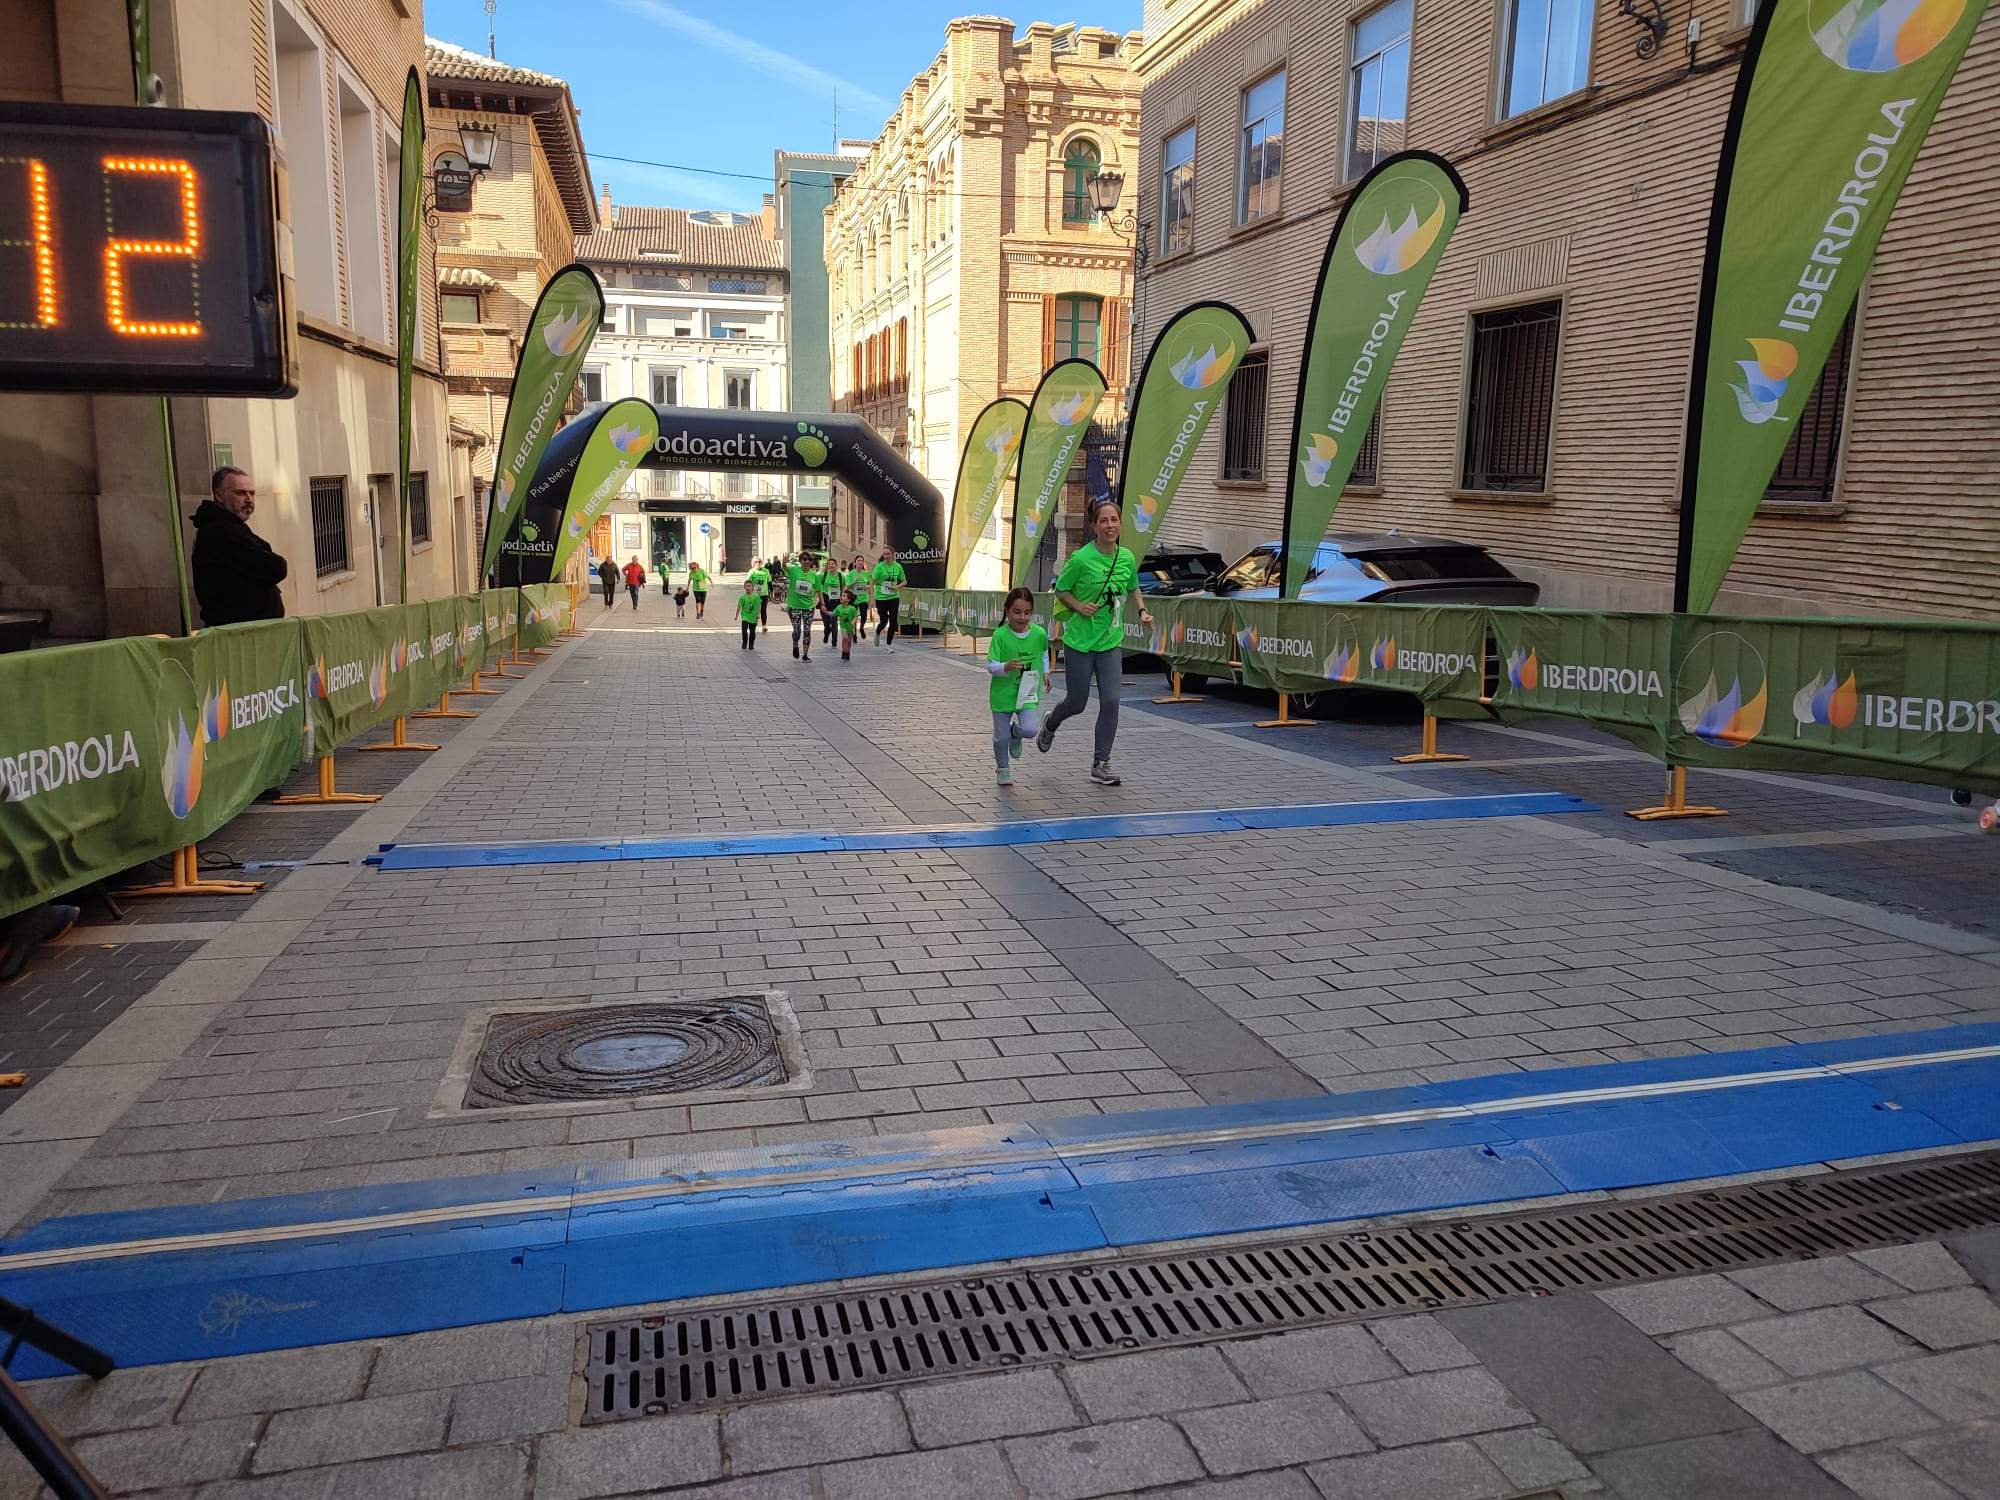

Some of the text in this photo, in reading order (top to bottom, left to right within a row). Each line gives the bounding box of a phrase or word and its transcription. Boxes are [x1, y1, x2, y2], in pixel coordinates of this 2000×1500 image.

[1778, 97, 1918, 333] IBERDROLA
[1327, 289, 1407, 434] IBERDROLA
[512, 370, 565, 475] IBERDROLA
[653, 430, 788, 459] odoactiva
[1150, 399, 1209, 497] IBERDROLA
[529, 481, 551, 498] Pisa
[547, 467, 570, 484] bien,
[582, 458, 630, 516] IBERDROLA
[851, 442, 868, 461] Pisa
[867, 458, 883, 479] bien,
[885, 474, 899, 490] vive
[1038, 433, 1077, 509] IBERDROLA
[726, 504, 757, 514] INSIDE
[501, 539, 554, 555] podoactiv
[1542, 663, 1664, 698] IBERDROLA
